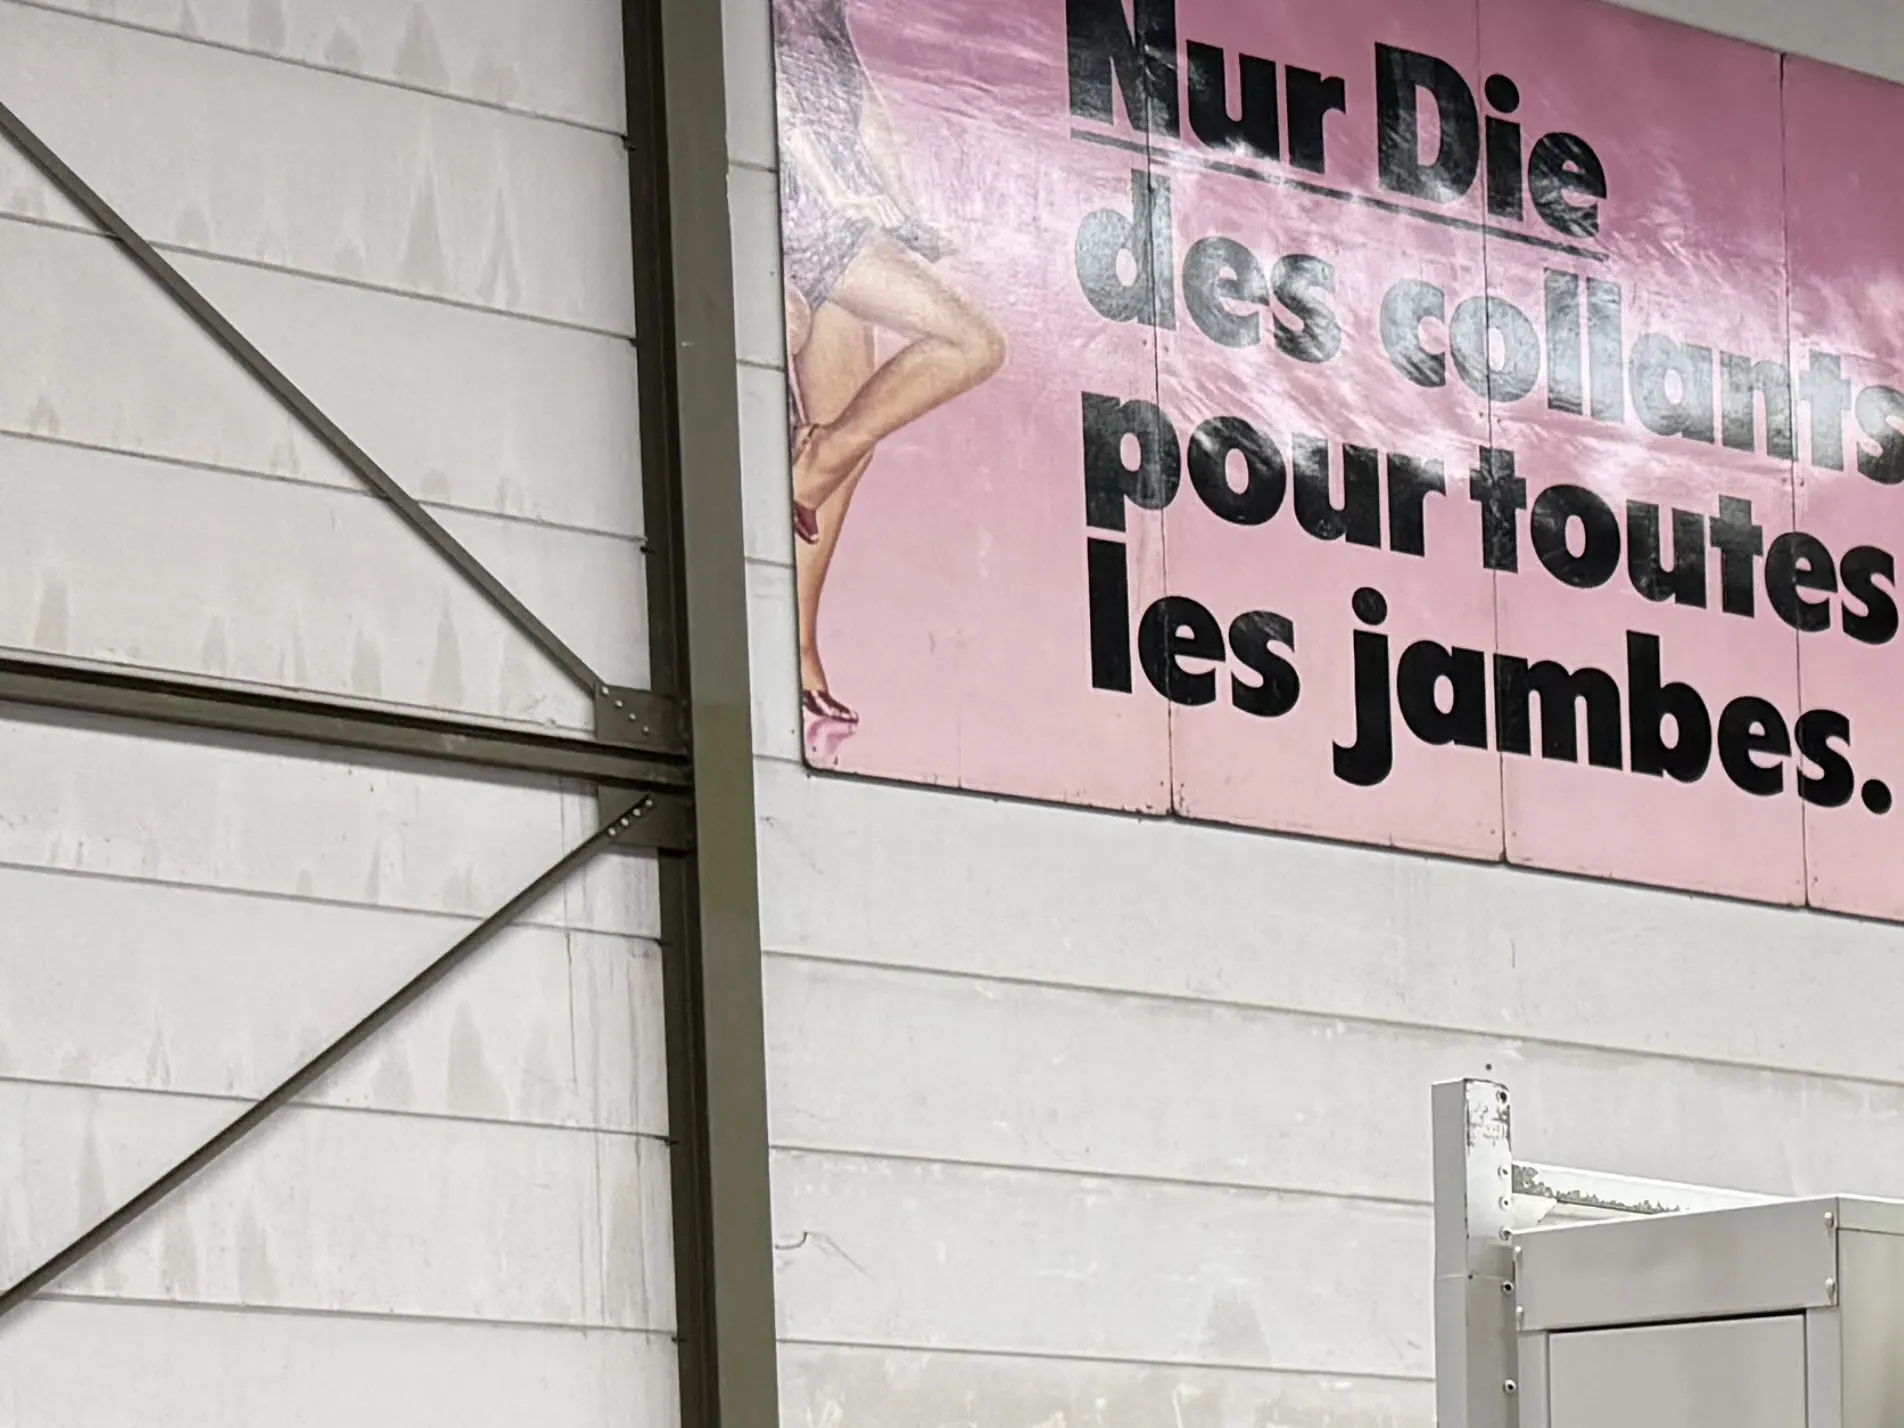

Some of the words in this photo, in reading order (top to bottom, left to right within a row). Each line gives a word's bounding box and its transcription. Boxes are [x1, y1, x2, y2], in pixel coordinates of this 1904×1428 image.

[1066, 0, 1346, 175] Nur
[1375, 41, 1608, 238] Die
[1074, 168, 1342, 363] des
[1081, 391, 1445, 556] pour
[1470, 446, 1900, 646] toutes
[1087, 526, 1301, 718] les
[1332, 586, 1894, 815] jambes.
